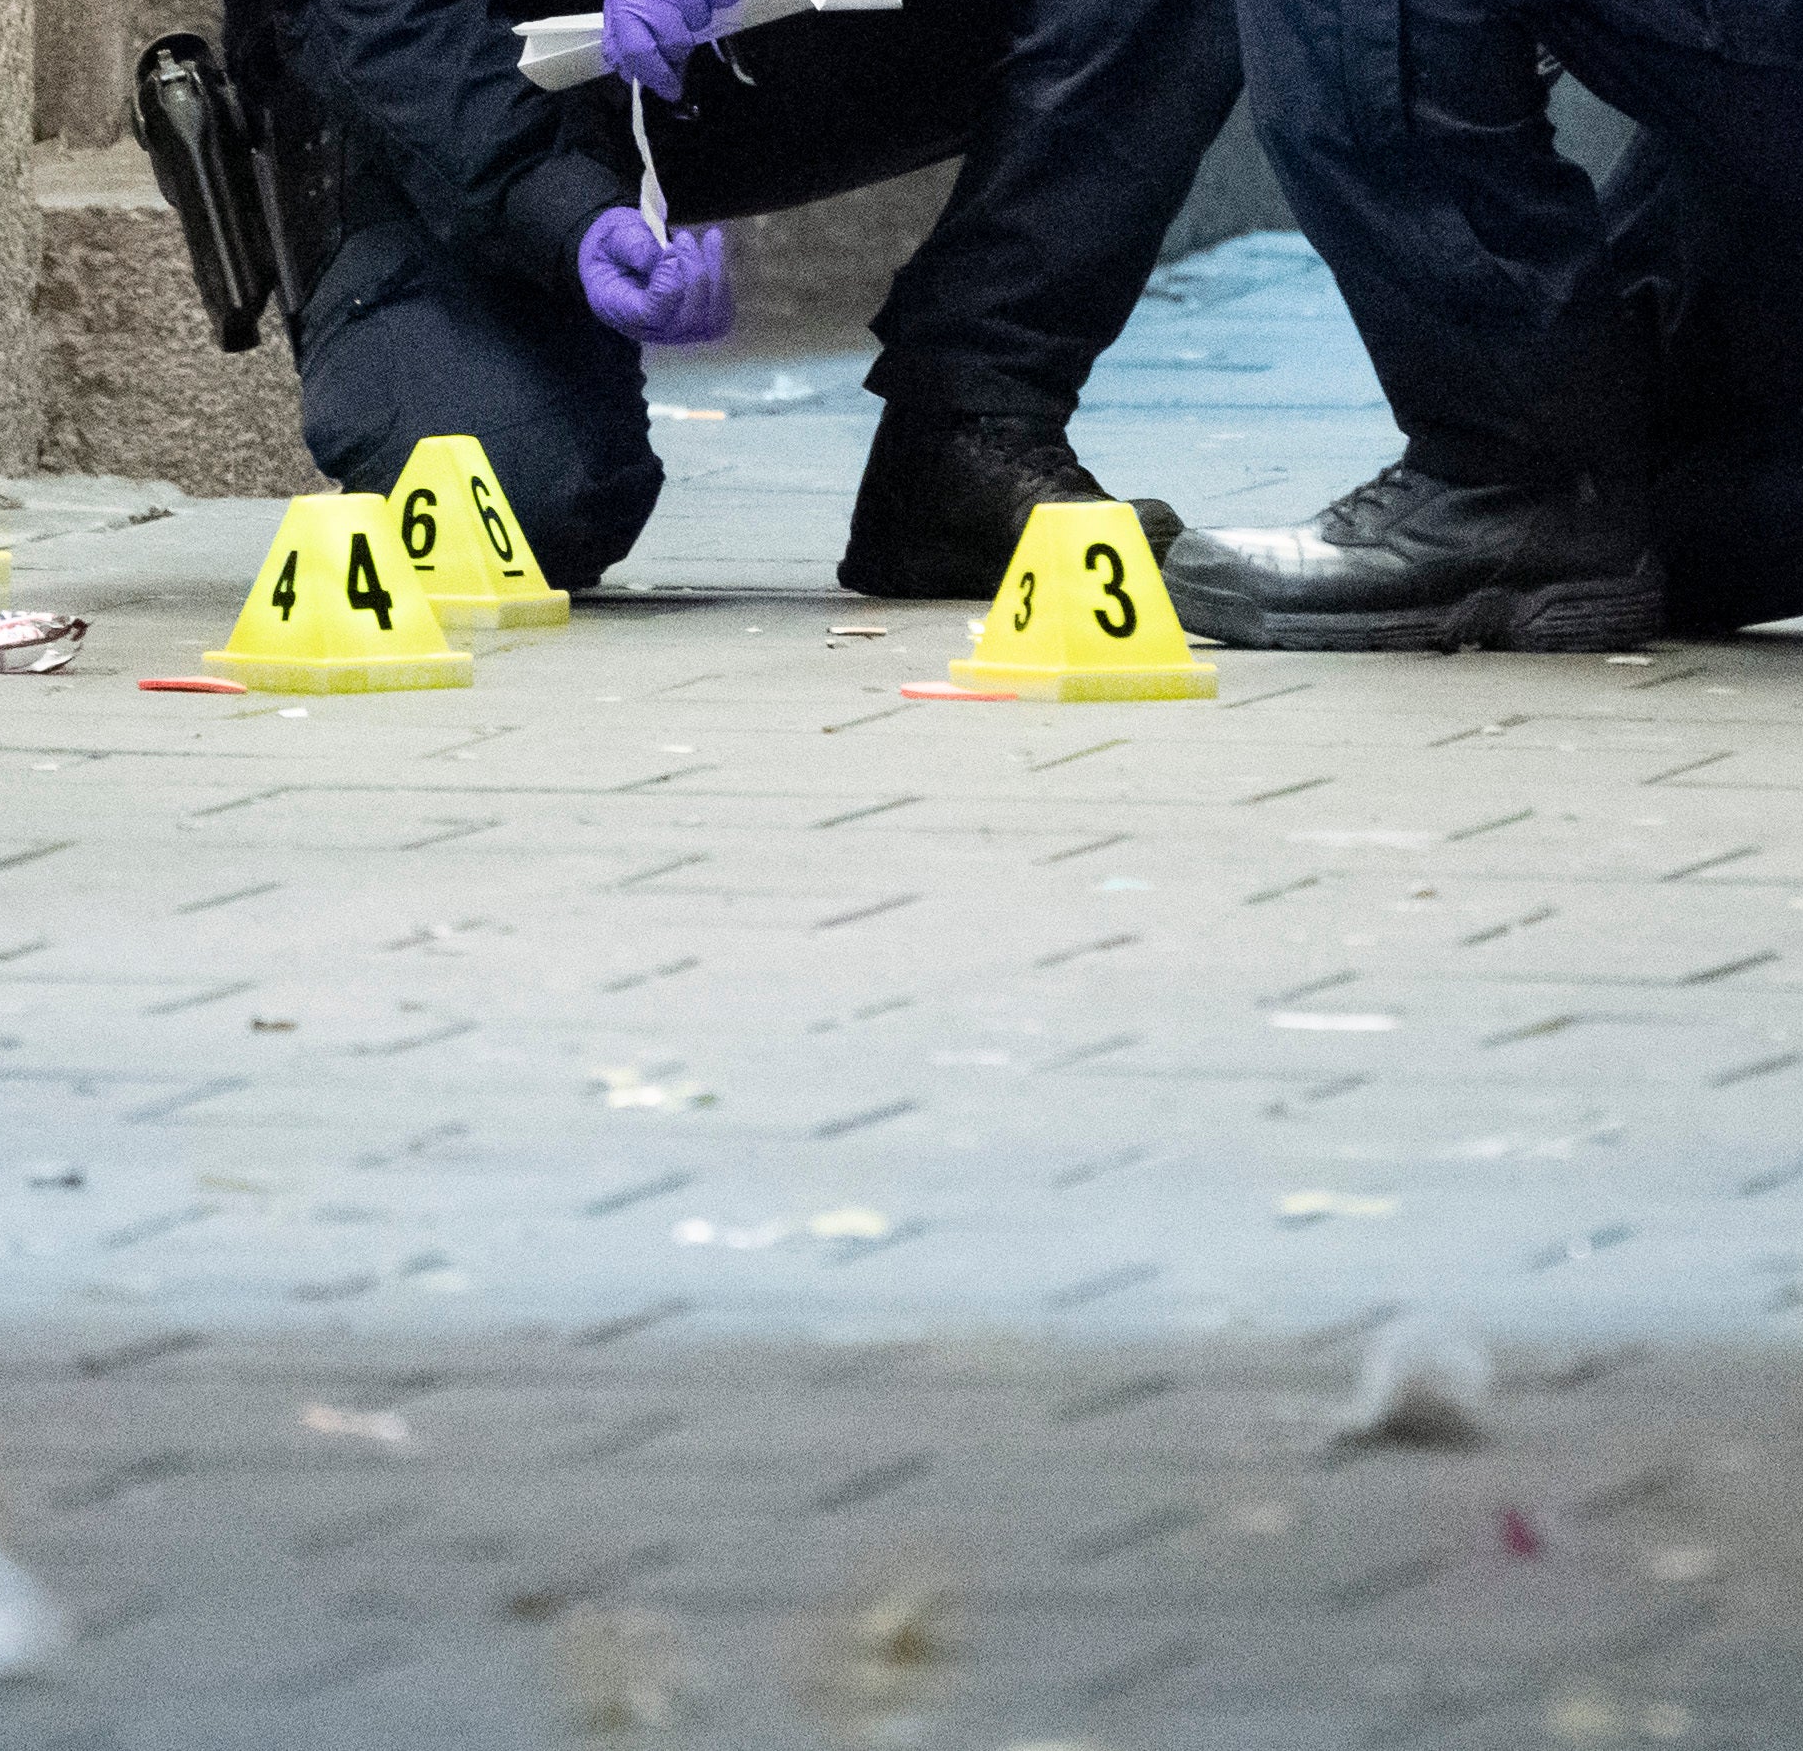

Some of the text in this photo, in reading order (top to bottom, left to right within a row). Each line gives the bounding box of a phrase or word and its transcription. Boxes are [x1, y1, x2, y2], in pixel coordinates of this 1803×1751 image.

[401, 488, 437, 559] 6
[471, 476, 514, 562] 6
[272, 550, 298, 621] 4
[347, 533, 392, 630] 4
[1014, 571, 1036, 631] 3
[1085, 543, 1137, 638] 3
